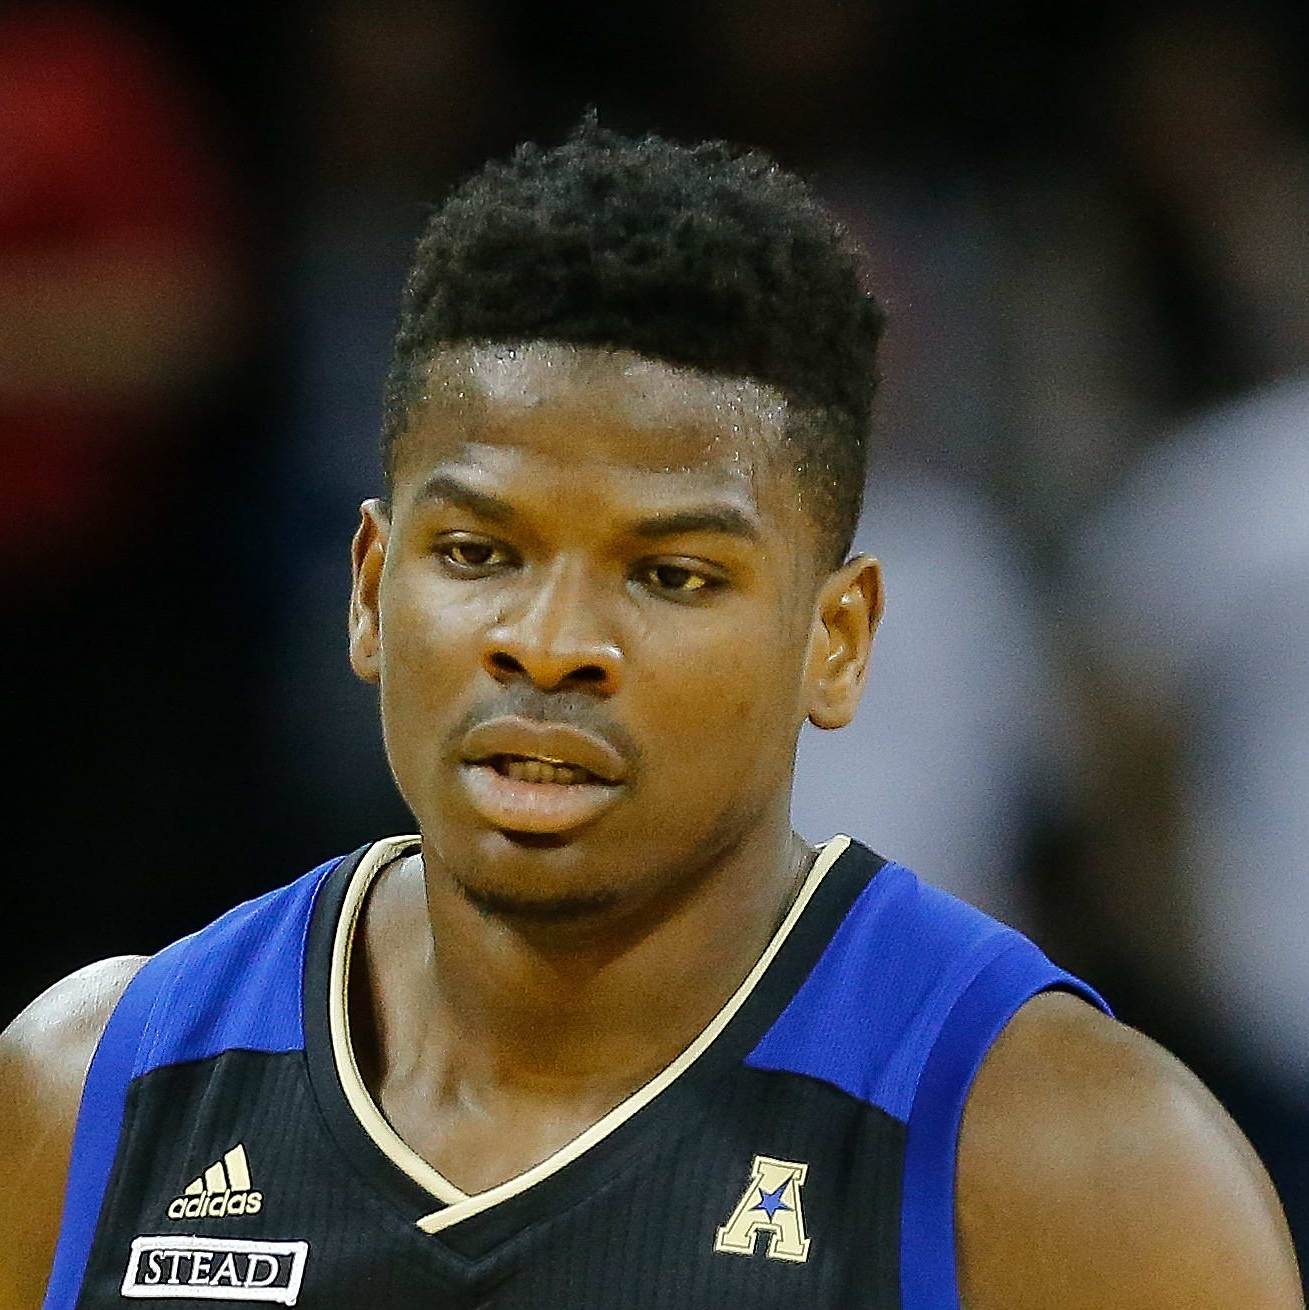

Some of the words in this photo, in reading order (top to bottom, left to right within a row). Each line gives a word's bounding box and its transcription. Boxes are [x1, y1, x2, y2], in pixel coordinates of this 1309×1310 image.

[168, 1189, 263, 1219] adidas
[714, 1155, 810, 1262] A
[144, 1250, 280, 1288] STEAD
